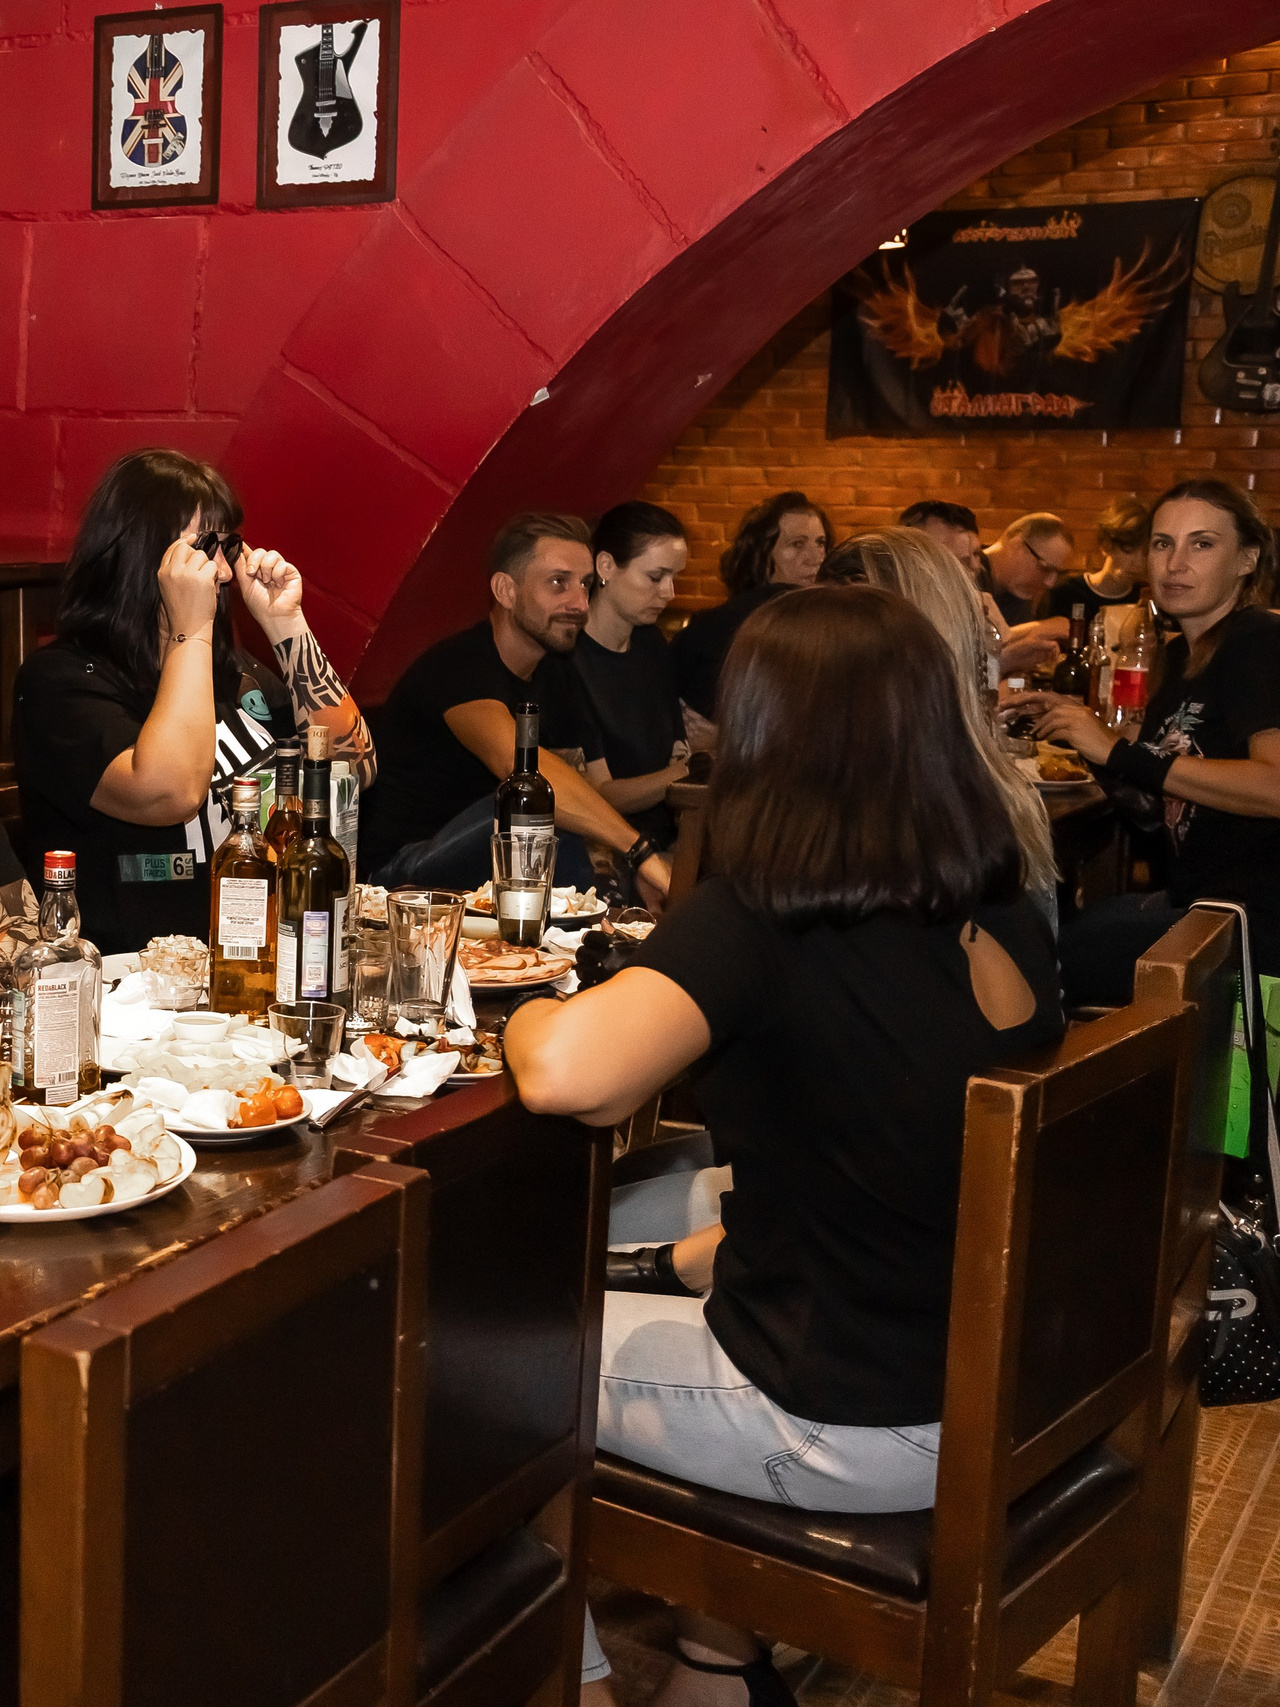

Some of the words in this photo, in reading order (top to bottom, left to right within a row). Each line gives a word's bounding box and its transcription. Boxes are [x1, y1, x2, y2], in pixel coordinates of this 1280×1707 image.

[144, 858, 166, 869] PLUS
[173, 857, 185, 876] 6
[37, 983, 67, 992] RED&BLACK
